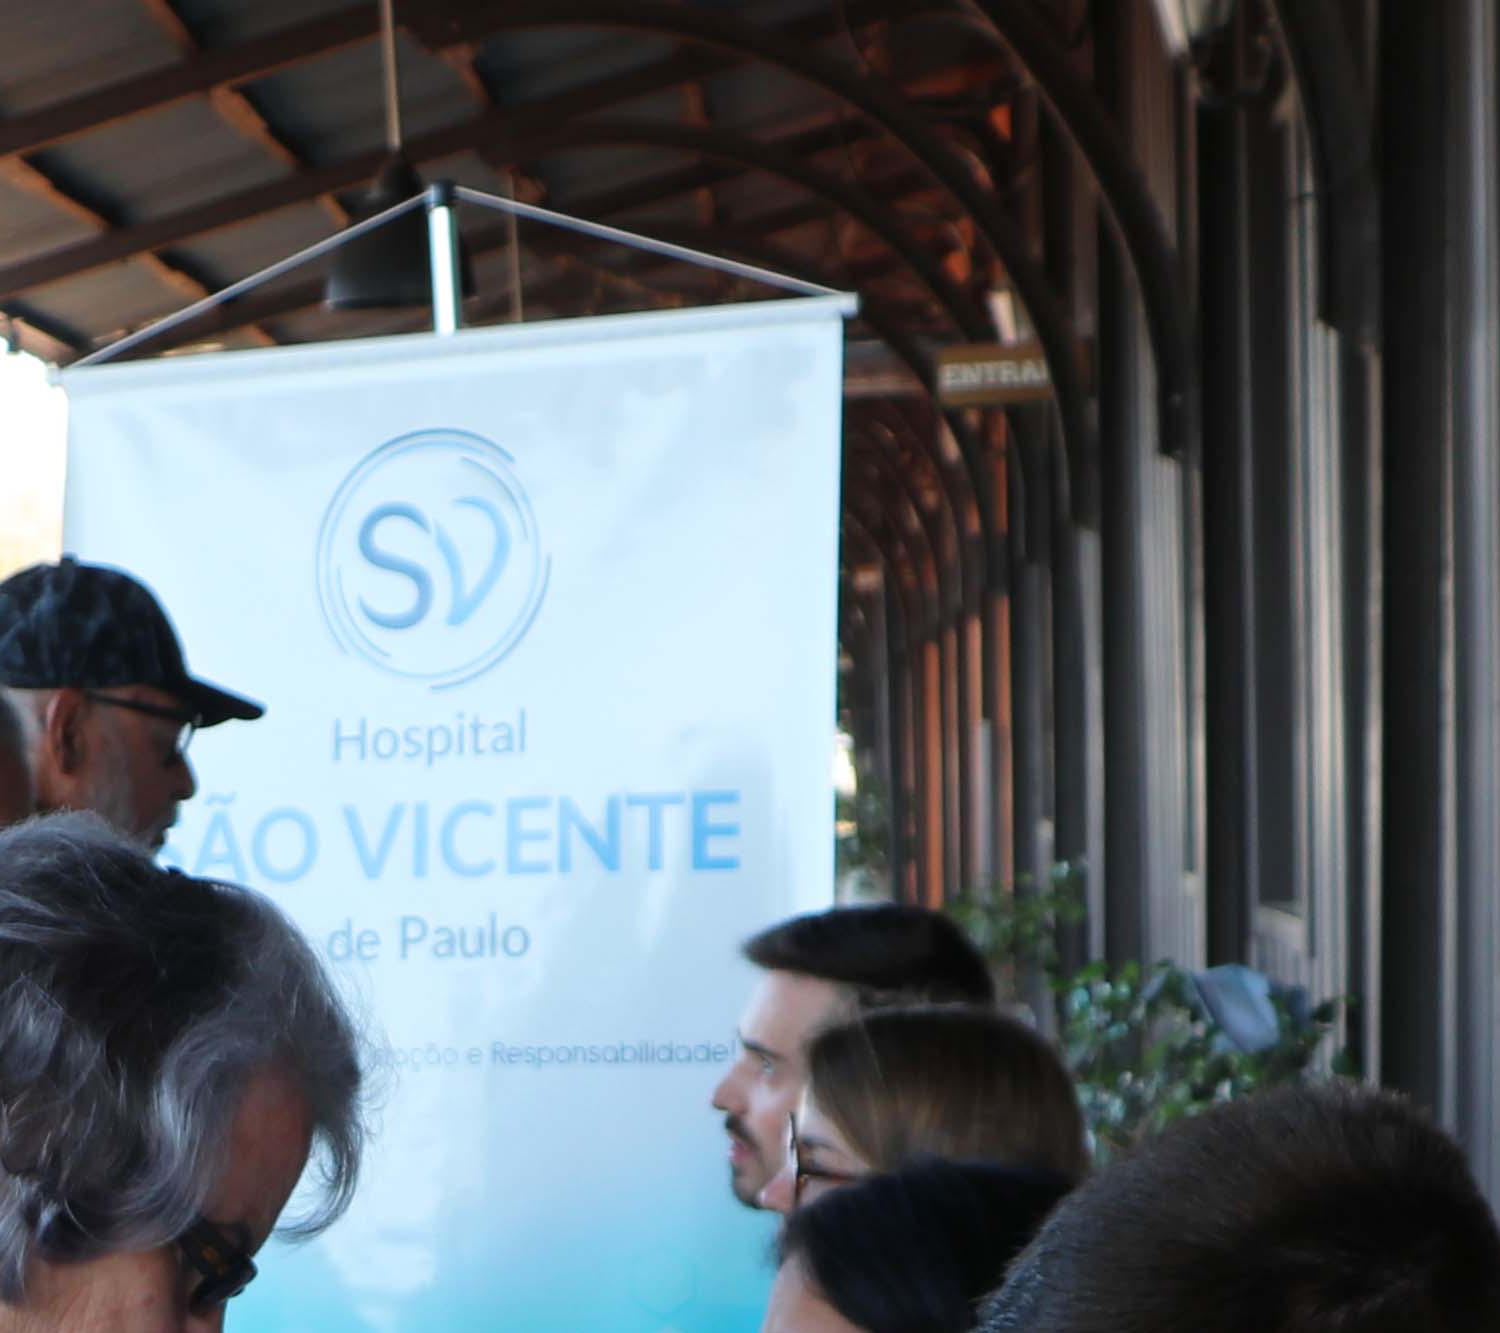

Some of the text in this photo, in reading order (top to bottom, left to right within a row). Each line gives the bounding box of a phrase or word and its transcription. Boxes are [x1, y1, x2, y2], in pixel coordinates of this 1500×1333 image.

[940, 359, 1048, 391] ENTRA
[357, 497, 510, 630] SV
[332, 709, 527, 766] Hospital
[342, 789, 743, 882] VICENTE
[327, 912, 530, 962] de Paulo
